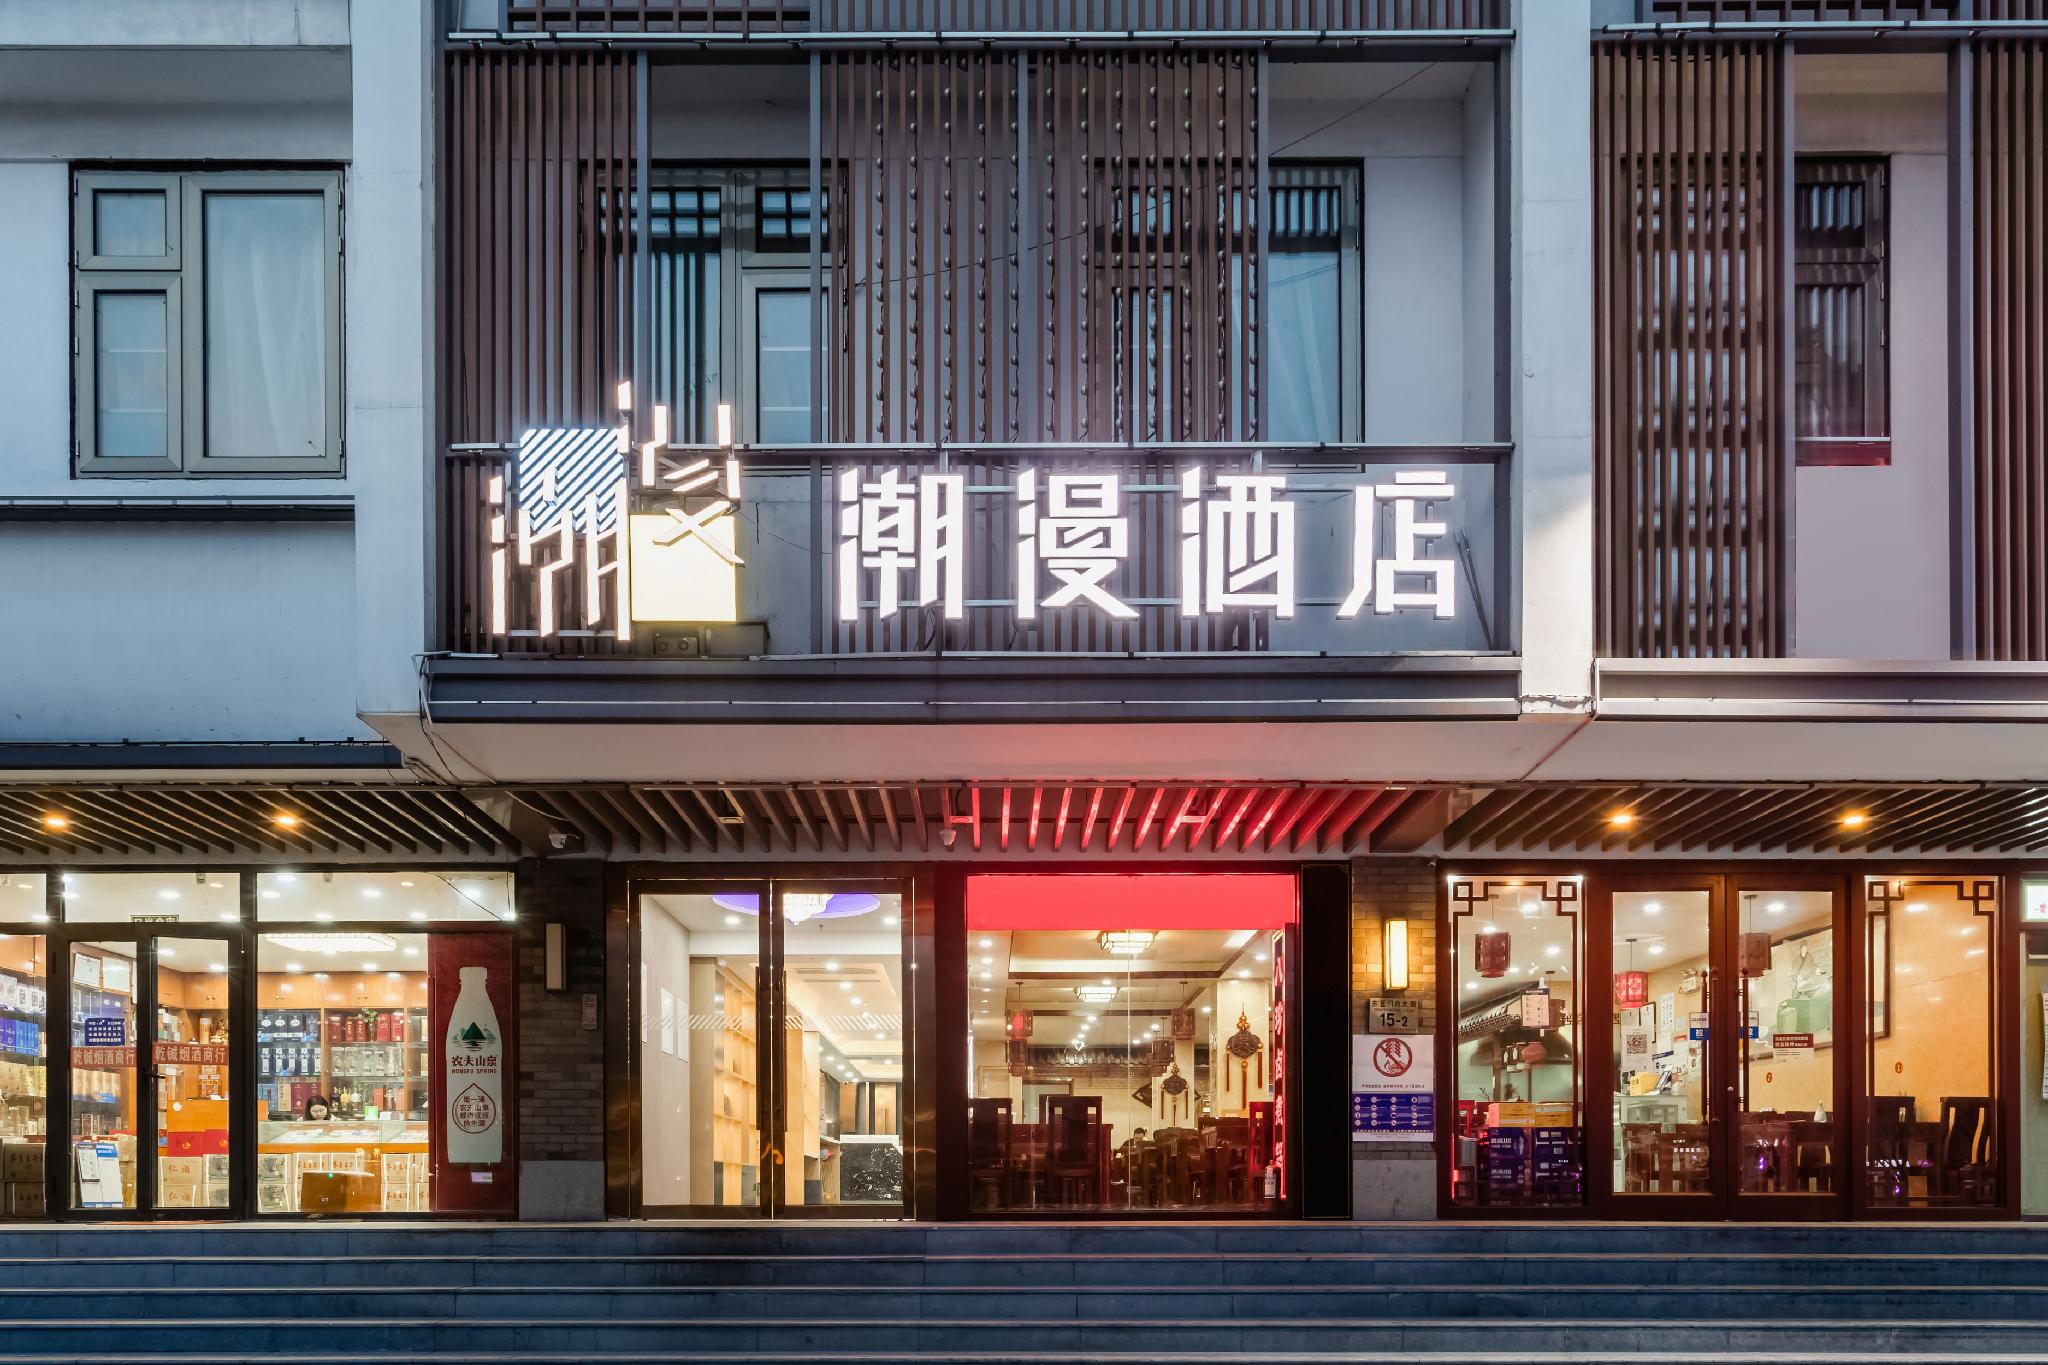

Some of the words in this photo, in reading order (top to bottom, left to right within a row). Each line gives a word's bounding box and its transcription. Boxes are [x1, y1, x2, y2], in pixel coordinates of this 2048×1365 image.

[839, 466, 1456, 621] 潮漫酒店
[1380, 1012, 1408, 1027] 15-2
[451, 1055, 497, 1067] 农夫山泉
